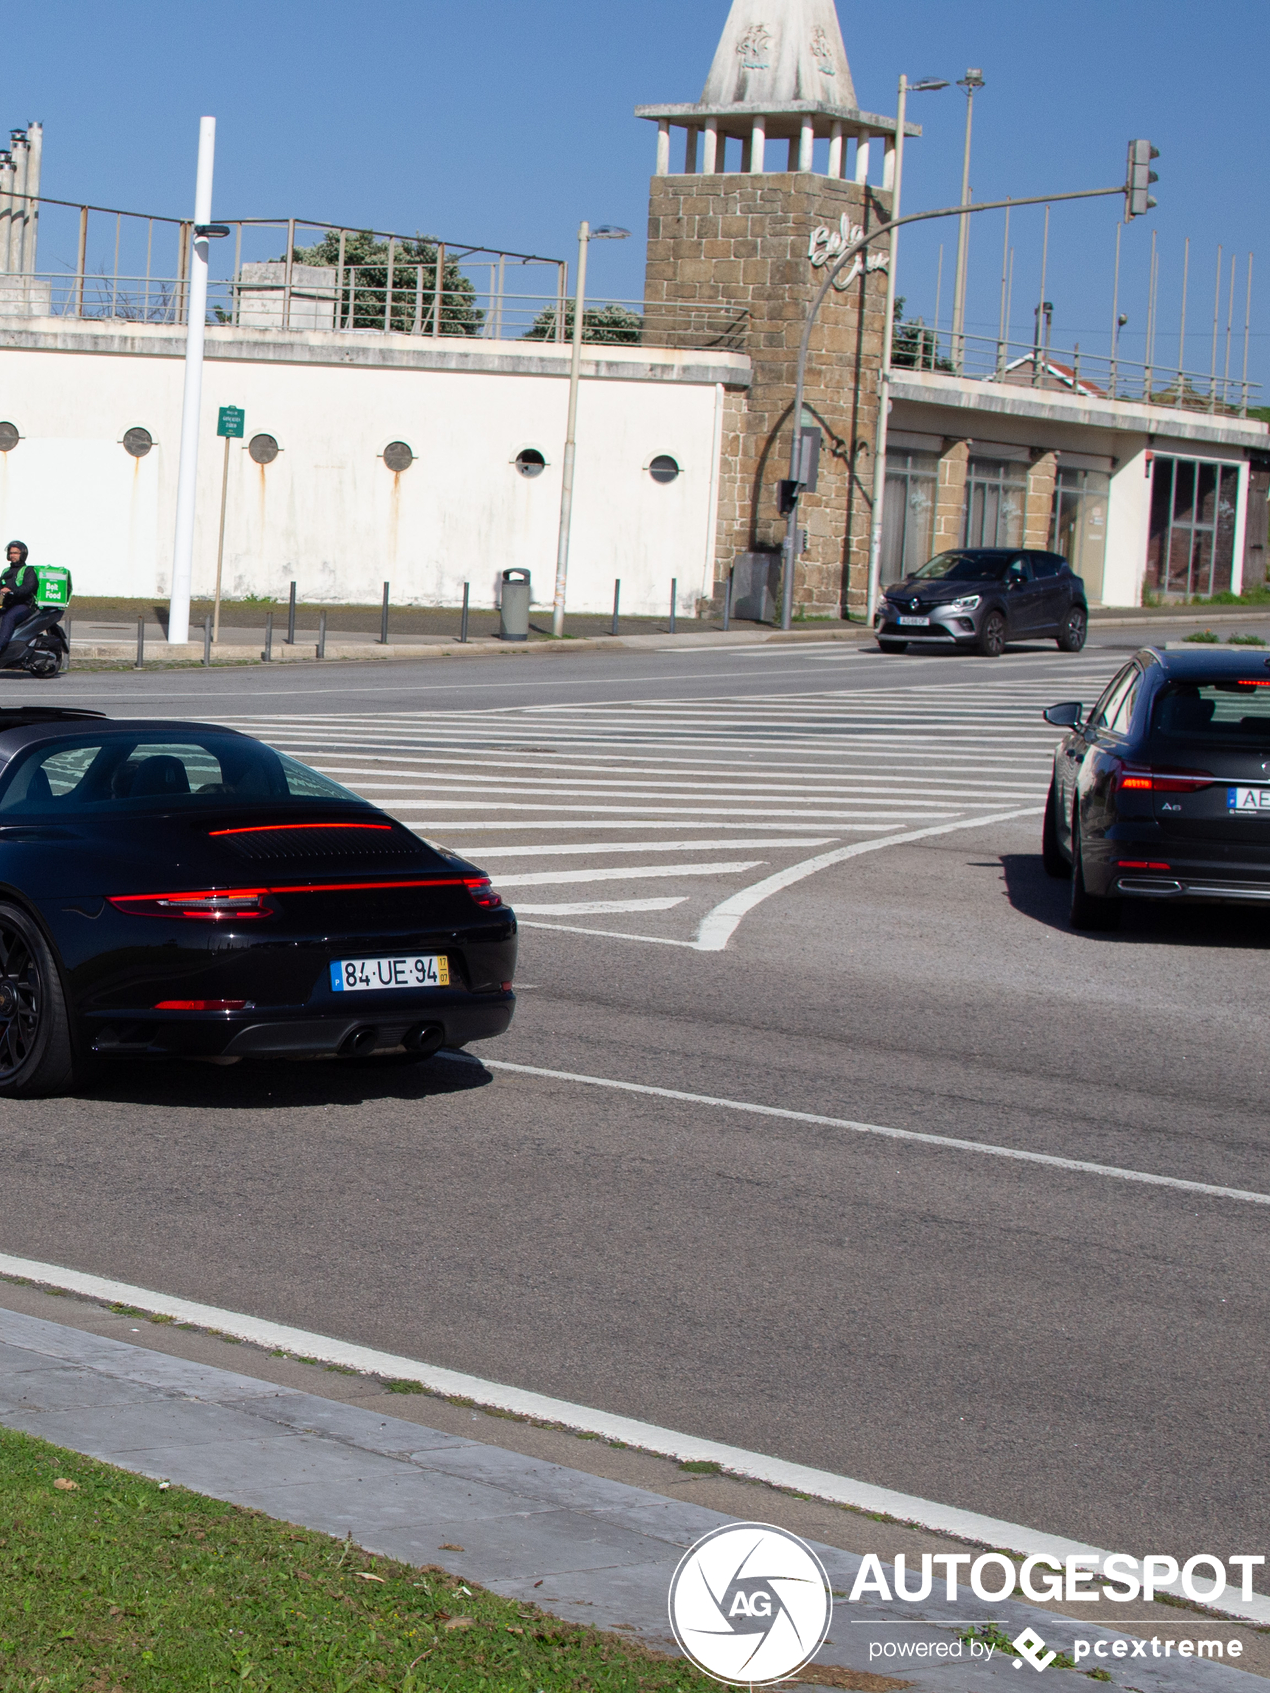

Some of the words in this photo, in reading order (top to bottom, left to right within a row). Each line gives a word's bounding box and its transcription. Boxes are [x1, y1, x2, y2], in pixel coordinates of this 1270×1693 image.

[46, 582, 59, 592] Bolt
[46, 591, 61, 599] Food
[1161, 802, 1182, 811] A6
[439, 957, 447, 967] 17
[440, 973, 448, 982] 07
